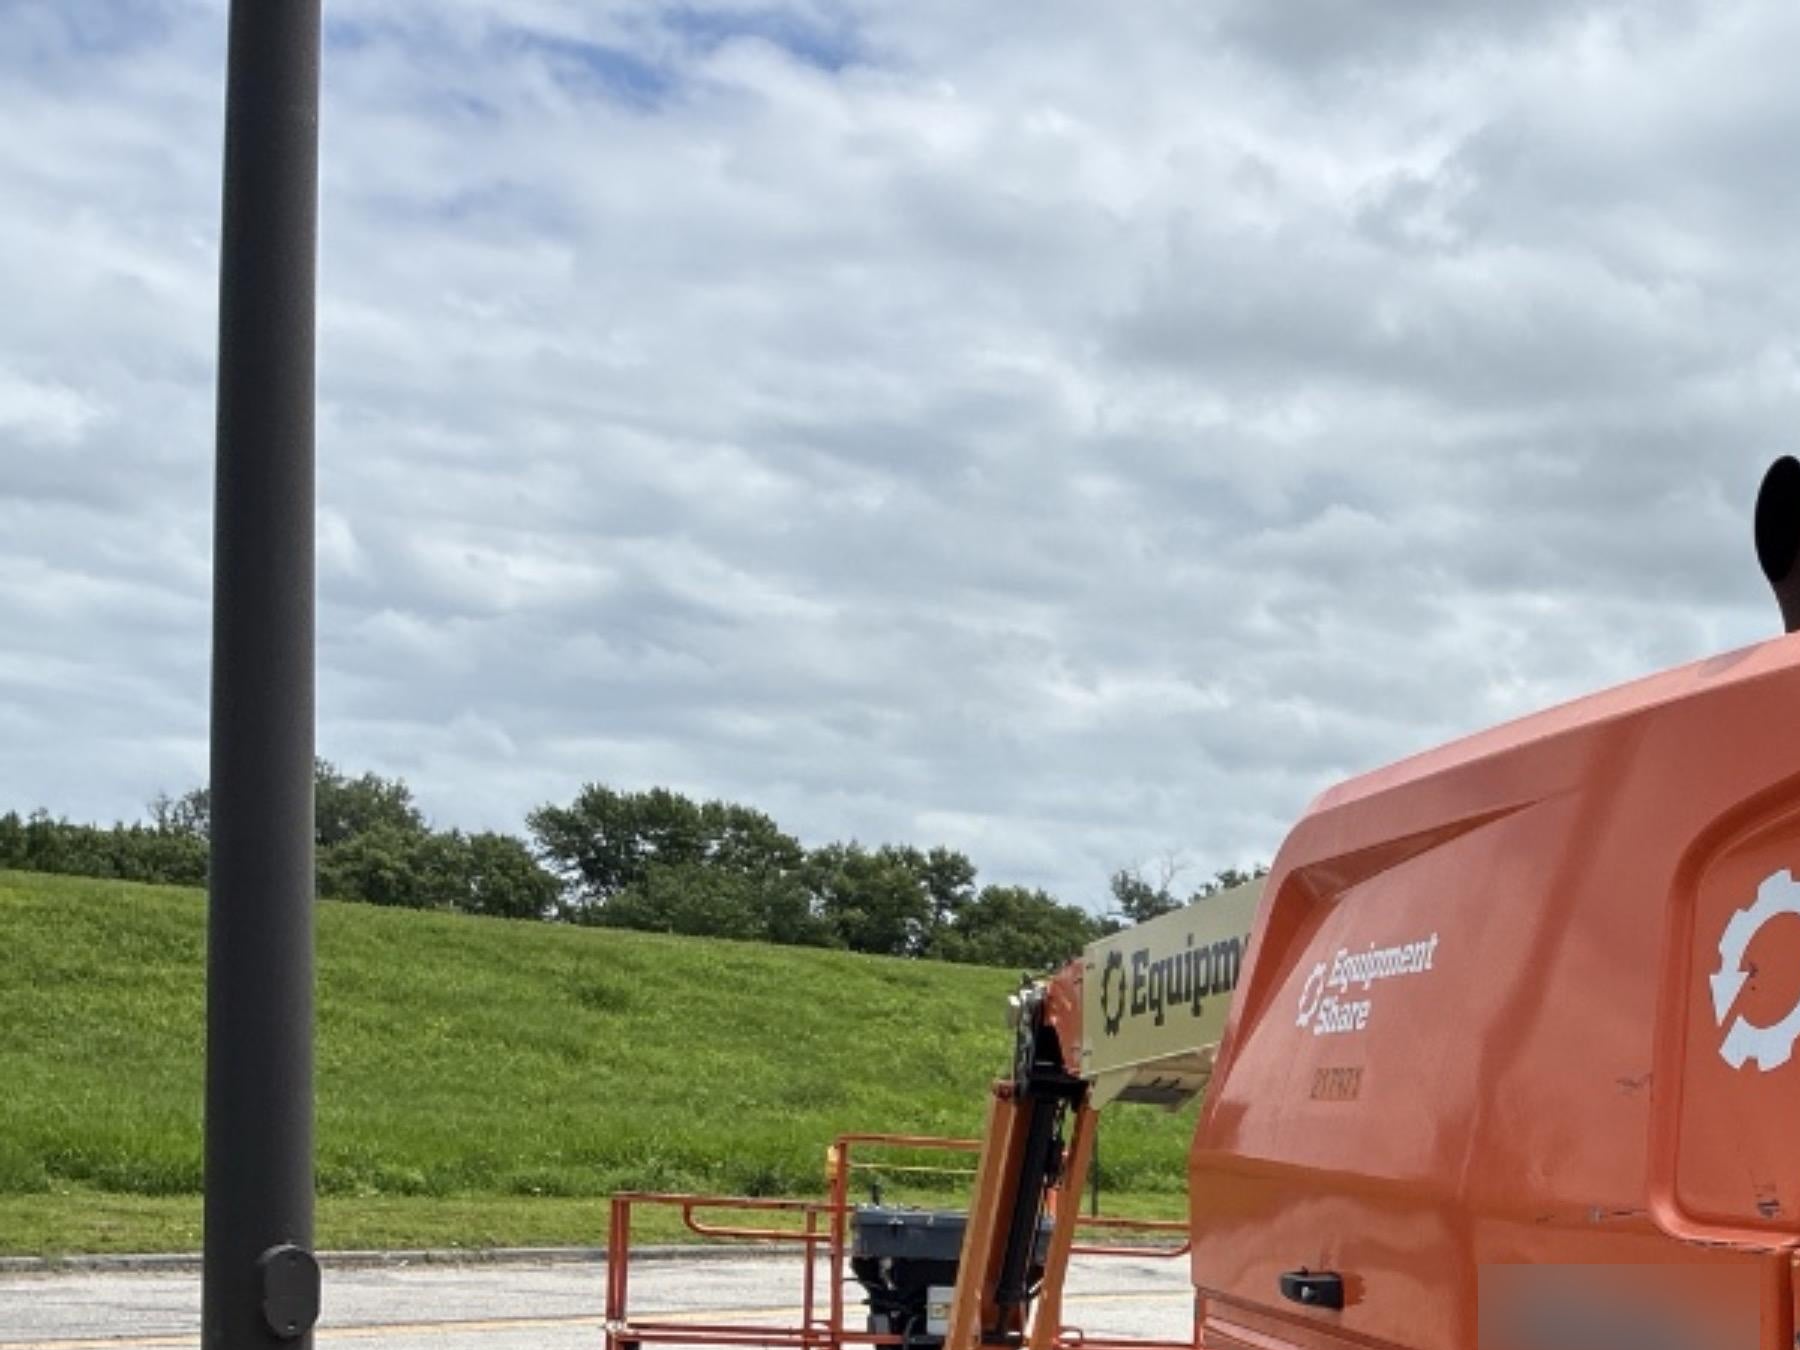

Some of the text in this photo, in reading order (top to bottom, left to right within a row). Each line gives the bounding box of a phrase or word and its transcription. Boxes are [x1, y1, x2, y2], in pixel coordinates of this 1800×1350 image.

[1131, 932, 1250, 1027] Equipm
[1326, 932, 1438, 994] Equipment
[1313, 996, 1372, 1036] Share
